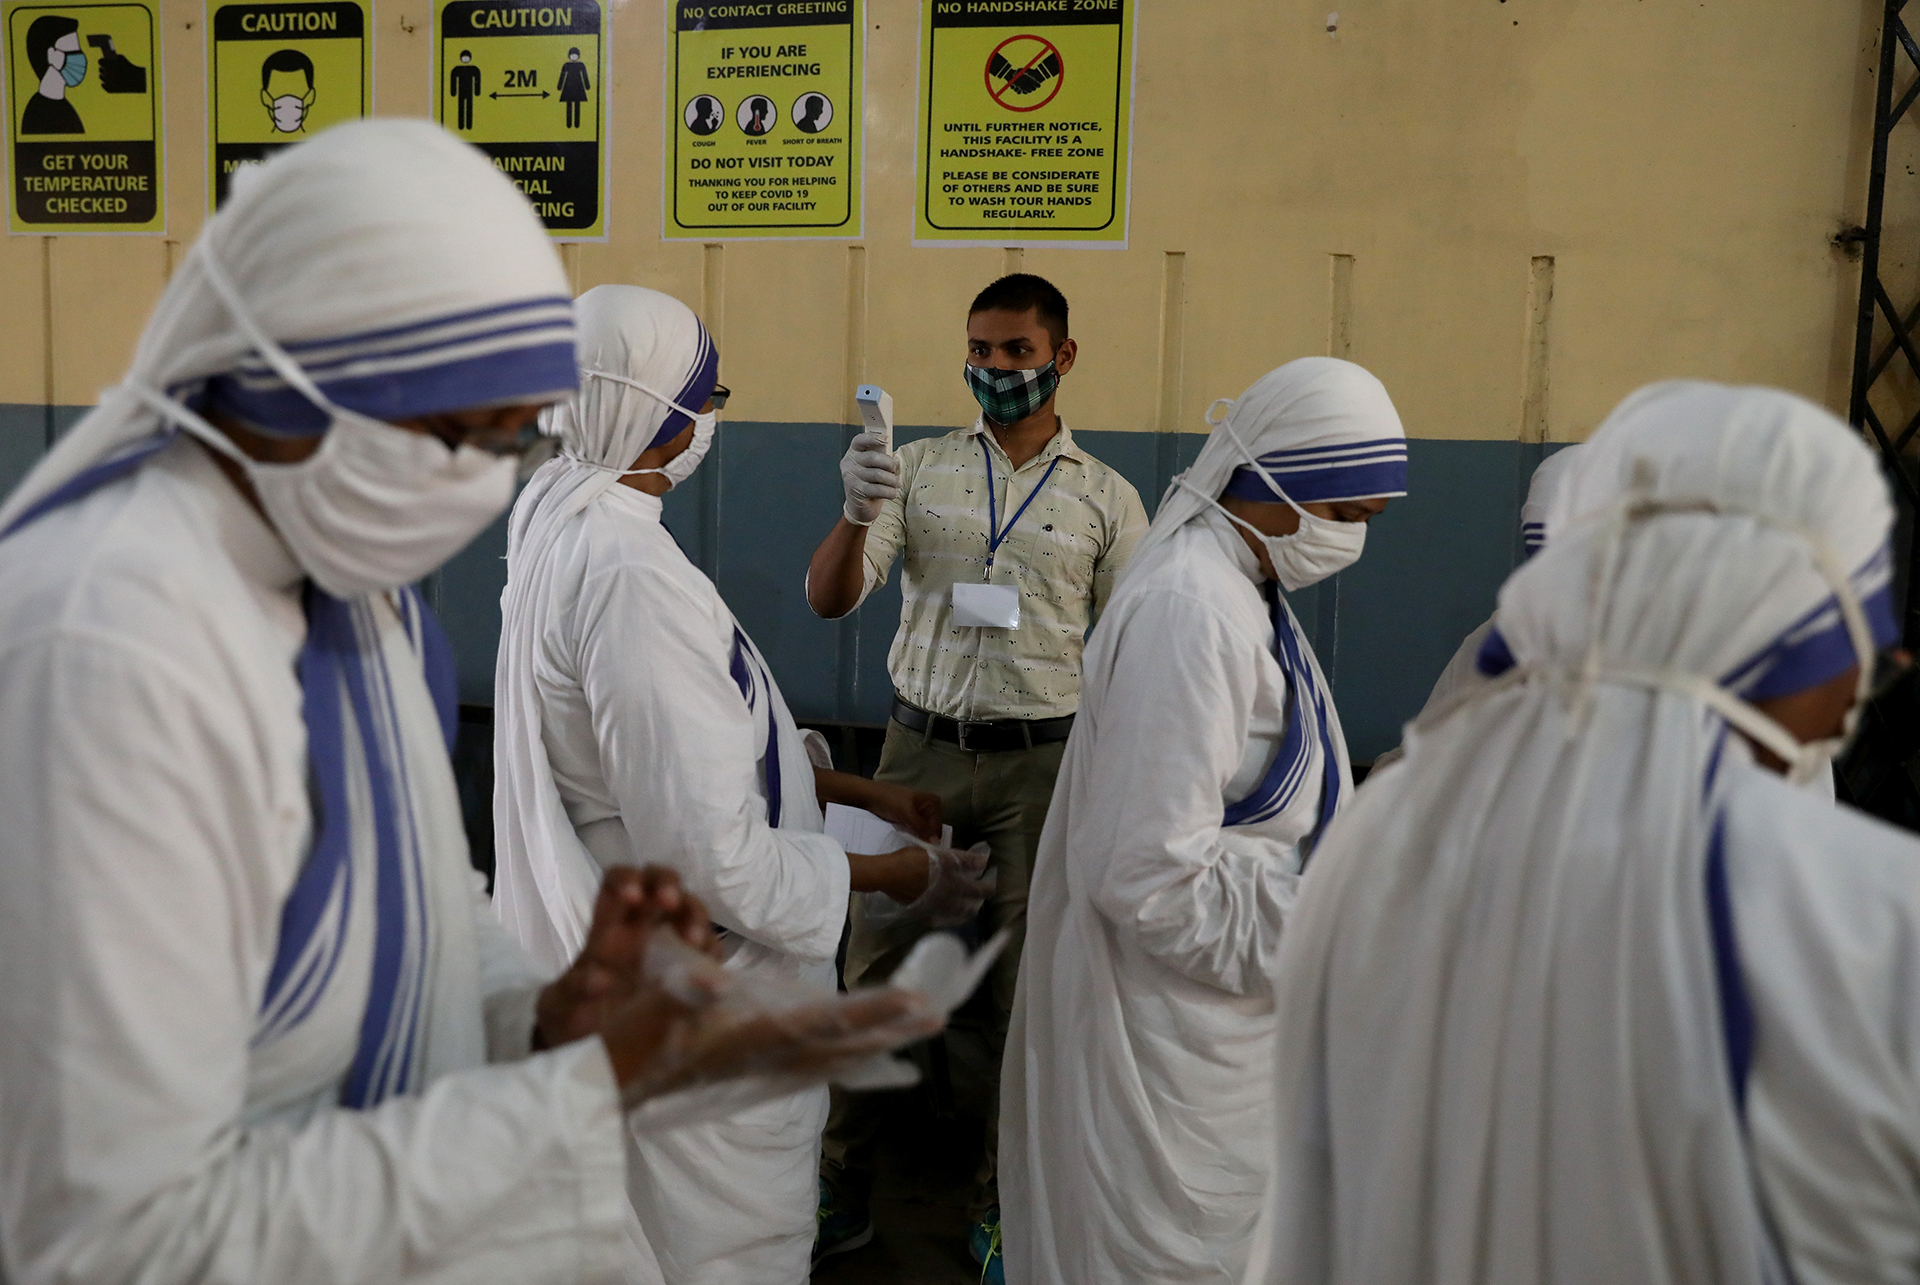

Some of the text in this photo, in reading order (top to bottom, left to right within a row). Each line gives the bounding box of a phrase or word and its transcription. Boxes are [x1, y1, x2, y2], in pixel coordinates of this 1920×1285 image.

[683, 1, 847, 19] NO CONTACT GREETING
[937, 0, 1118, 14] NO HANDSHAKE ZONE
[241, 11, 337, 32] CAUTION
[470, 7, 572, 29] CAUTION
[721, 44, 807, 60] IF YOU ARE
[707, 63, 821, 79] EXPERIENCING
[503, 69, 537, 88] 2M
[943, 122, 1102, 132] UNTIL FURTHER NOTICE,
[963, 135, 1082, 145] THIS FACILITY IS A
[940, 148, 1104, 157] HANDSHAKE- FREE ZONE
[42, 153, 129, 170] GET YOUR
[488, 156, 565, 172] AINTAIN
[691, 156, 834, 170] DO NOT VISIT TODAY
[689, 176, 836, 187] THANKING YOU FOR HELPING
[942, 170, 1100, 180] PLEASE BE CONSIDERATE
[24, 175, 148, 192] TEMPERATURE
[513, 179, 552, 195] CIAL
[942, 183, 1099, 193] OF OTHERS AND BE SURE
[715, 189, 809, 199] TO KEEP COVID 19
[46, 197, 128, 213] CHECKED
[708, 202, 817, 211] OUT OF OUR FACILITY
[948, 197, 965, 206] TO
[968, 197, 1006, 206] WASH
[1047, 197, 1092, 206] HANDS
[983, 209, 1055, 219] REGULARLY.
